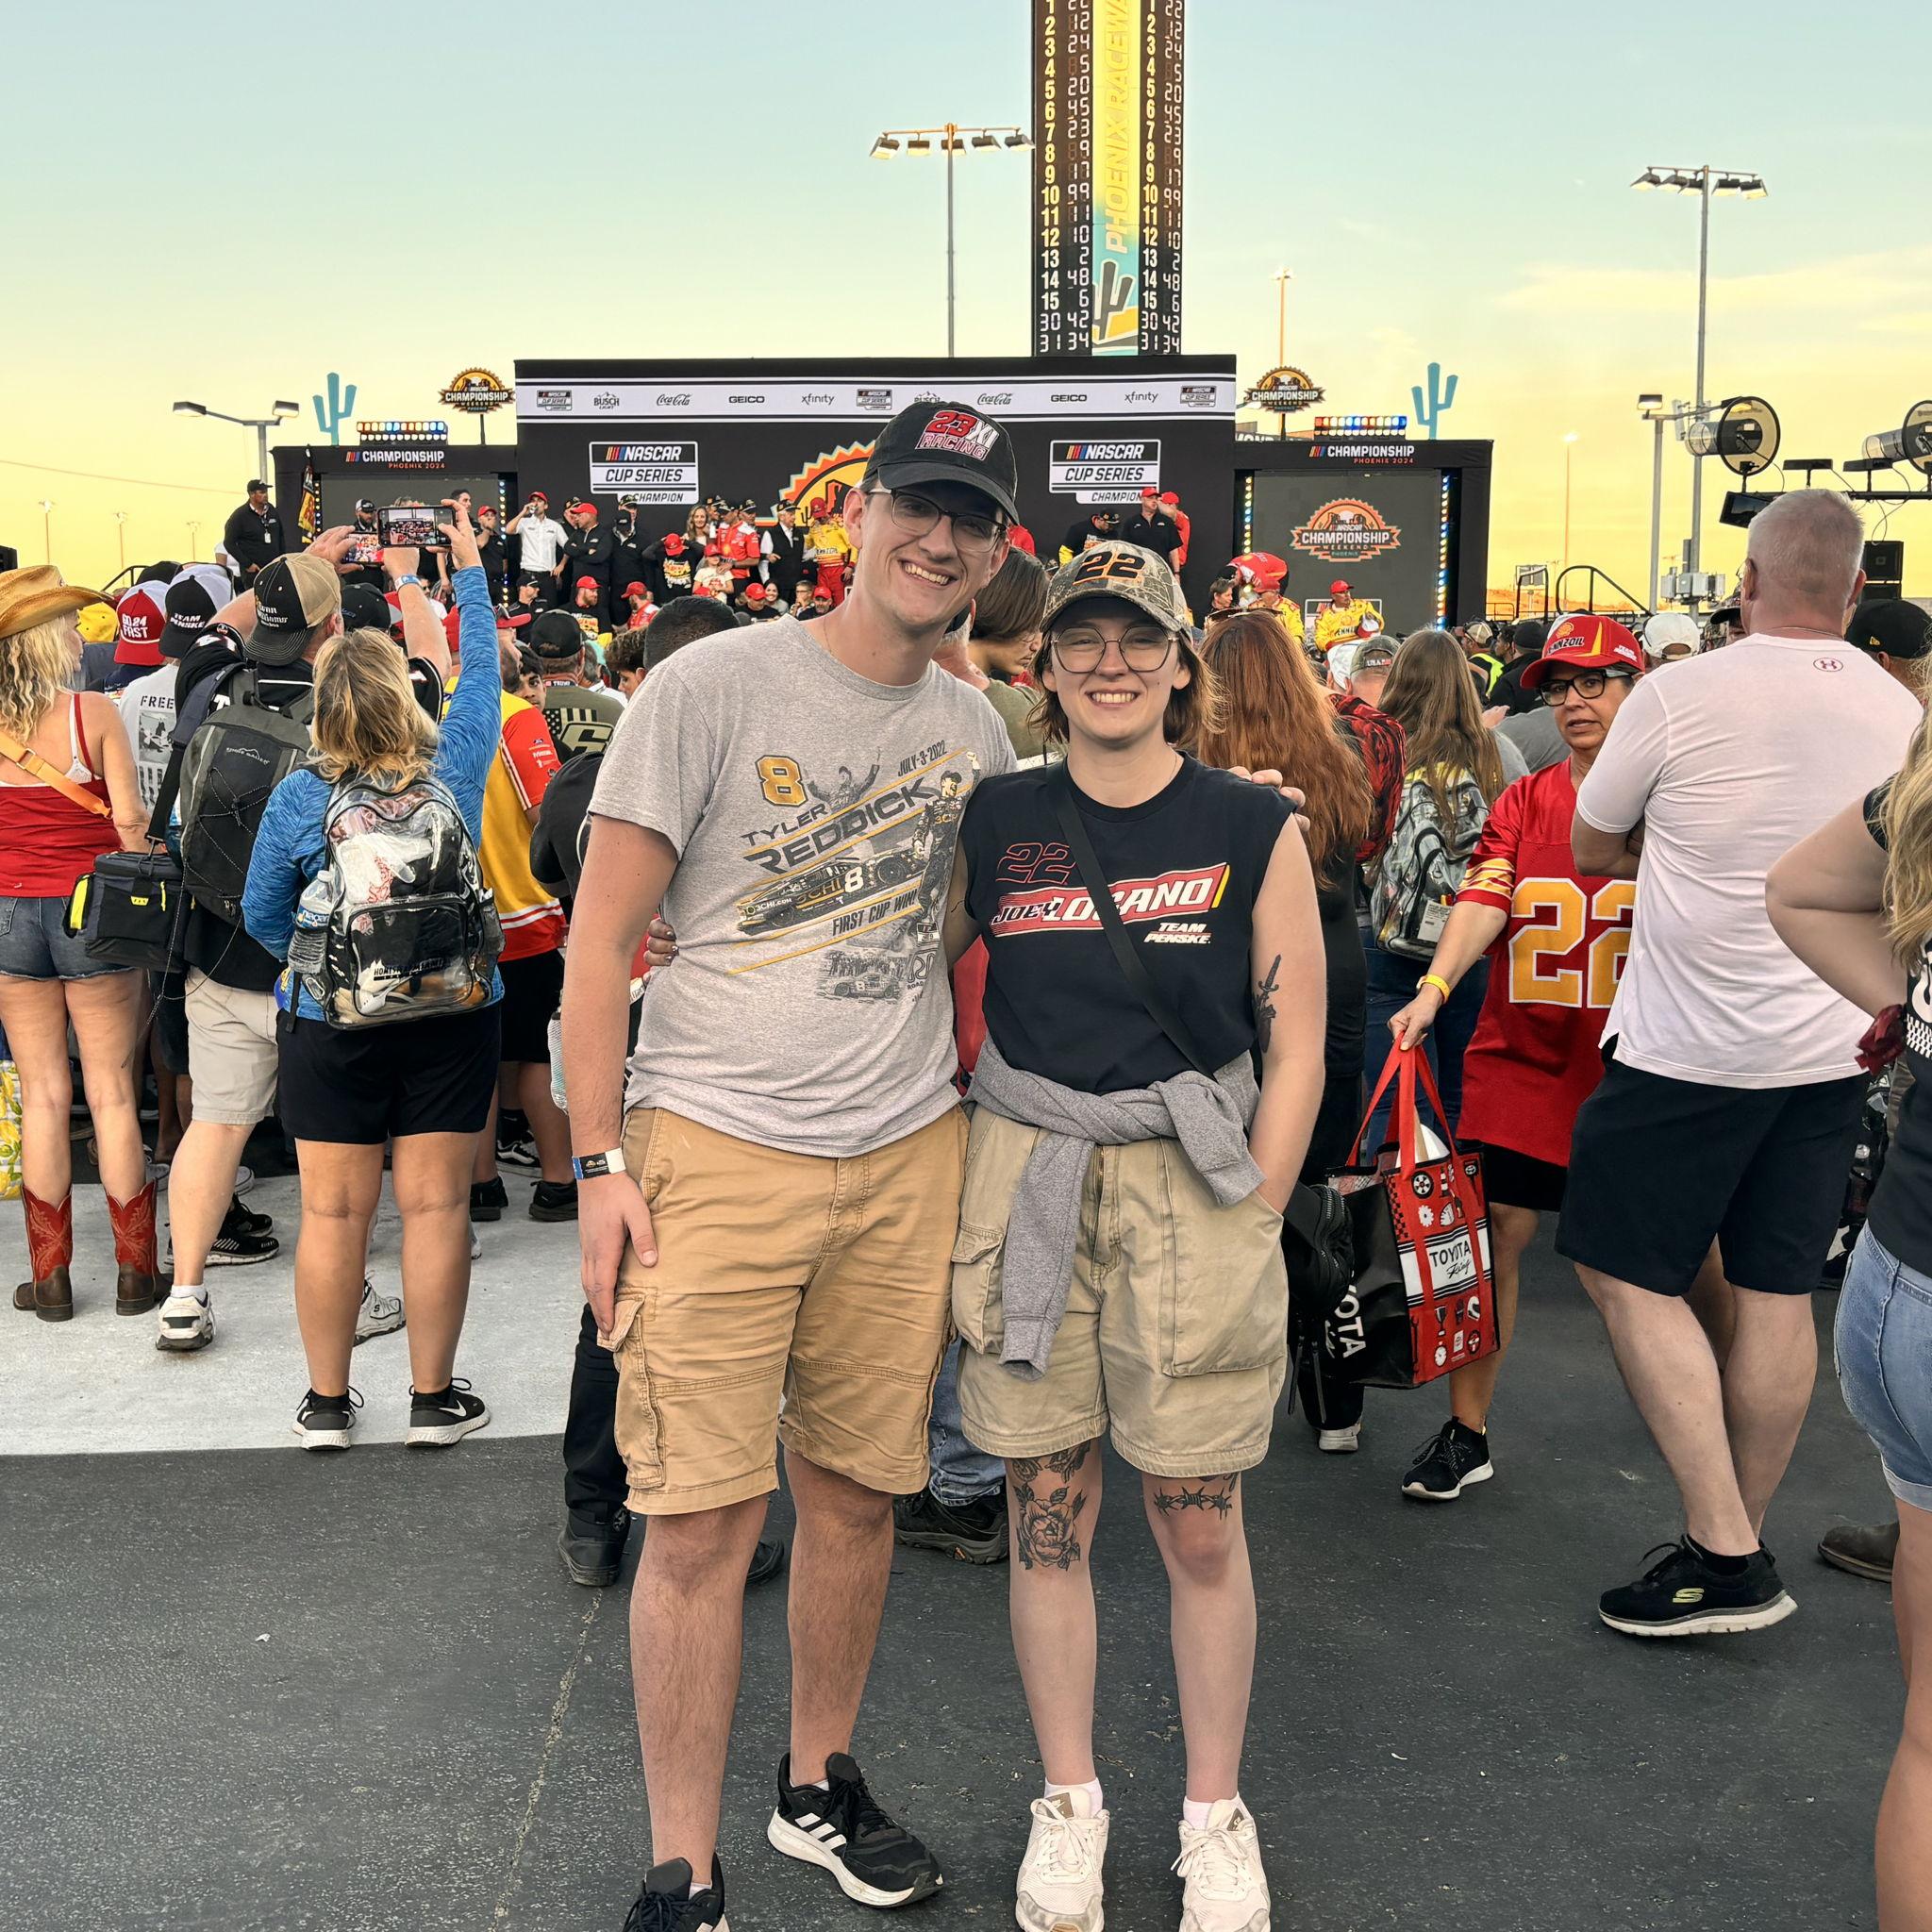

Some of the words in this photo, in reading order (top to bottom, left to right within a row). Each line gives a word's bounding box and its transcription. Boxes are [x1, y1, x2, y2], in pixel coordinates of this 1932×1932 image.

[1045, 16, 1056, 36] 2
[1074, 11, 1090, 30] 12
[1146, 13, 1156, 34] 2
[1170, 21, 1182, 40] 12
[1045, 38, 1056, 57] 3
[1068, 34, 1090, 53] 24
[1146, 35, 1156, 56] 3
[1165, 40, 1182, 60] 24
[1045, 58, 1056, 77] 4
[1079, 54, 1090, 74] 5
[1146, 57, 1156, 76] 4
[1174, 63, 1182, 82] 5
[1045, 80, 1056, 99] 5
[1068, 75, 1090, 96] 20
[1146, 77, 1156, 97] 5
[1165, 82, 1182, 103] 20
[1045, 101, 1056, 121] 6
[1068, 97, 1090, 117] 45
[1146, 99, 1156, 119] 6
[1164, 104, 1181, 125] 45
[1045, 123, 1056, 142] 7
[1068, 119, 1090, 139] 23
[1146, 121, 1156, 140] 7
[1164, 125, 1181, 145] 23
[1045, 143, 1056, 163] 8
[1079, 140, 1090, 158] 9
[1146, 142, 1155, 161] 8
[1174, 147, 1181, 165] 9
[1045, 165, 1056, 184] 9
[1074, 161, 1090, 179] 17
[1105, 111, 1129, 254] PHOENIX
[1146, 163, 1155, 182] 9
[1169, 169, 1181, 186] 17
[1041, 185, 1059, 205] 10
[1068, 183, 1090, 200] 99
[1143, 184, 1158, 204] 10
[1164, 188, 1180, 207] 99
[1041, 207, 1059, 226] 11
[1074, 205, 1090, 222] 11
[1143, 206, 1158, 225] 11
[1168, 211, 1181, 228] 11
[1041, 228, 1059, 247] 12
[1074, 225, 1090, 243] 10
[1142, 226, 1158, 246] 12
[1168, 230, 1180, 250] 10
[1041, 249, 1059, 268] 13
[1079, 246, 1090, 265] 2
[1142, 248, 1158, 267] 13
[1173, 253, 1180, 271] 2
[1041, 271, 1059, 289] 14
[1068, 268, 1089, 287] 48
[1142, 270, 1158, 289] 14
[1163, 273, 1180, 291] 48
[1041, 292, 1059, 310] 15
[1079, 289, 1089, 308] 6
[1142, 291, 1158, 309] 15
[1173, 294, 1180, 312] 6
[1041, 313, 1060, 331] 30
[1068, 310, 1089, 328] 42
[1141, 311, 1158, 331] 30
[1162, 315, 1179, 333] 42
[1041, 335, 1060, 353] 31
[1068, 332, 1089, 351] 34
[1141, 332, 1158, 351] 31
[1162, 335, 1179, 353] 34
[445, 391, 508, 401] CHAMPIONSHIP
[593, 397, 620, 407] BUSCH
[728, 395, 765, 404] GEICO
[801, 392, 835, 406] xfinity
[1050, 394, 1088, 403] GEICO
[1124, 391, 1159, 404] xfinity
[1252, 391, 1319, 401] CHAMPIONSHIP
[362, 450, 444, 462] CHAMPIONSHIP
[624, 445, 682, 461] NASCAR
[919, 432, 987, 458] RACING
[1085, 444, 1144, 459] NASCAR
[1327, 445, 1415, 458] CHAMPIONSHIP
[606, 468, 633, 482] CUP
[634, 468, 683, 482] SERIES
[1065, 468, 1093, 482] CUP
[1094, 467, 1144, 481] SERIES
[633, 492, 684, 503] CHAMPION
[1091, 491, 1141, 502] CHAMPION
[1302, 531, 1390, 544] CHAMPIONSHIP
[1073, 550, 1146, 586] 22
[123, 625, 148, 639] FAST
[140, 695, 175, 709] FREE
[897, 740, 948, 777] JULY-3-2022
[755, 755, 808, 808] 8
[740, 803, 828, 847] TYLER
[743, 777, 936, 874] REDDICK
[996, 842, 1075, 885] 22
[844, 866, 864, 893] 8
[832, 909, 863, 936] FIRST
[868, 902, 890, 924] CUP
[893, 889, 917, 913] WIN!
[991, 901, 1060, 925] JOEY
[1158, 922, 1207, 933] TEAM
[1508, 876, 1637, 1008] 22
[1429, 1241, 1472, 1267] TOYOTA
